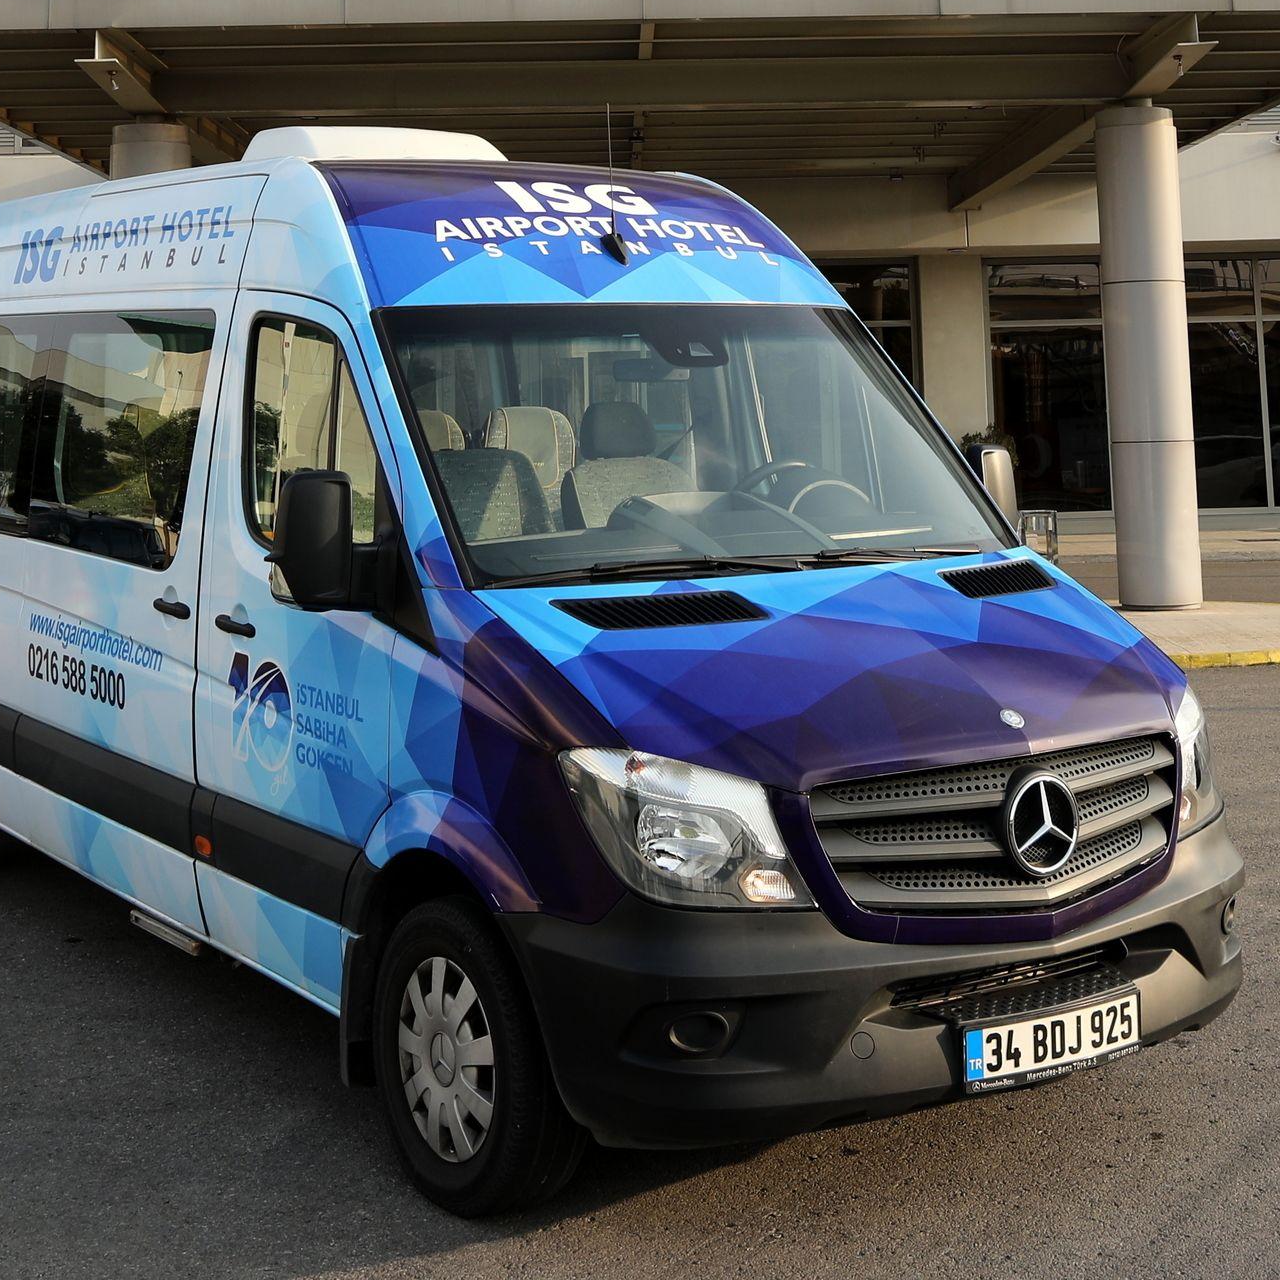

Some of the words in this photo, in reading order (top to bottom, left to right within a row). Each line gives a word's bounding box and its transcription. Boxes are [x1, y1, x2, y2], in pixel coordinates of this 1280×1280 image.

[493, 180, 659, 216] ISG
[13, 225, 65, 285] ISG
[70, 214, 156, 254] AIRPORT
[160, 205, 235, 244] HOTEL
[434, 215, 613, 243] AIRPORT
[626, 217, 765, 249] HOTEL
[63, 243, 228, 277] ISTANBUL
[441, 240, 780, 267] ISTANBUL
[29, 612, 163, 672] www.isgairporthotel.com
[28, 643, 59, 685] 0216
[61, 655, 87, 696] 588
[90, 664, 126, 710] 5000
[985, 1029, 1022, 1073] 34
[1033, 1016, 1083, 1063] BDJ
[1090, 1001, 1132, 1048] 925
[969, 1058, 983, 1071] TR
[1026, 1066, 1073, 1082] Mercedes-Benz
